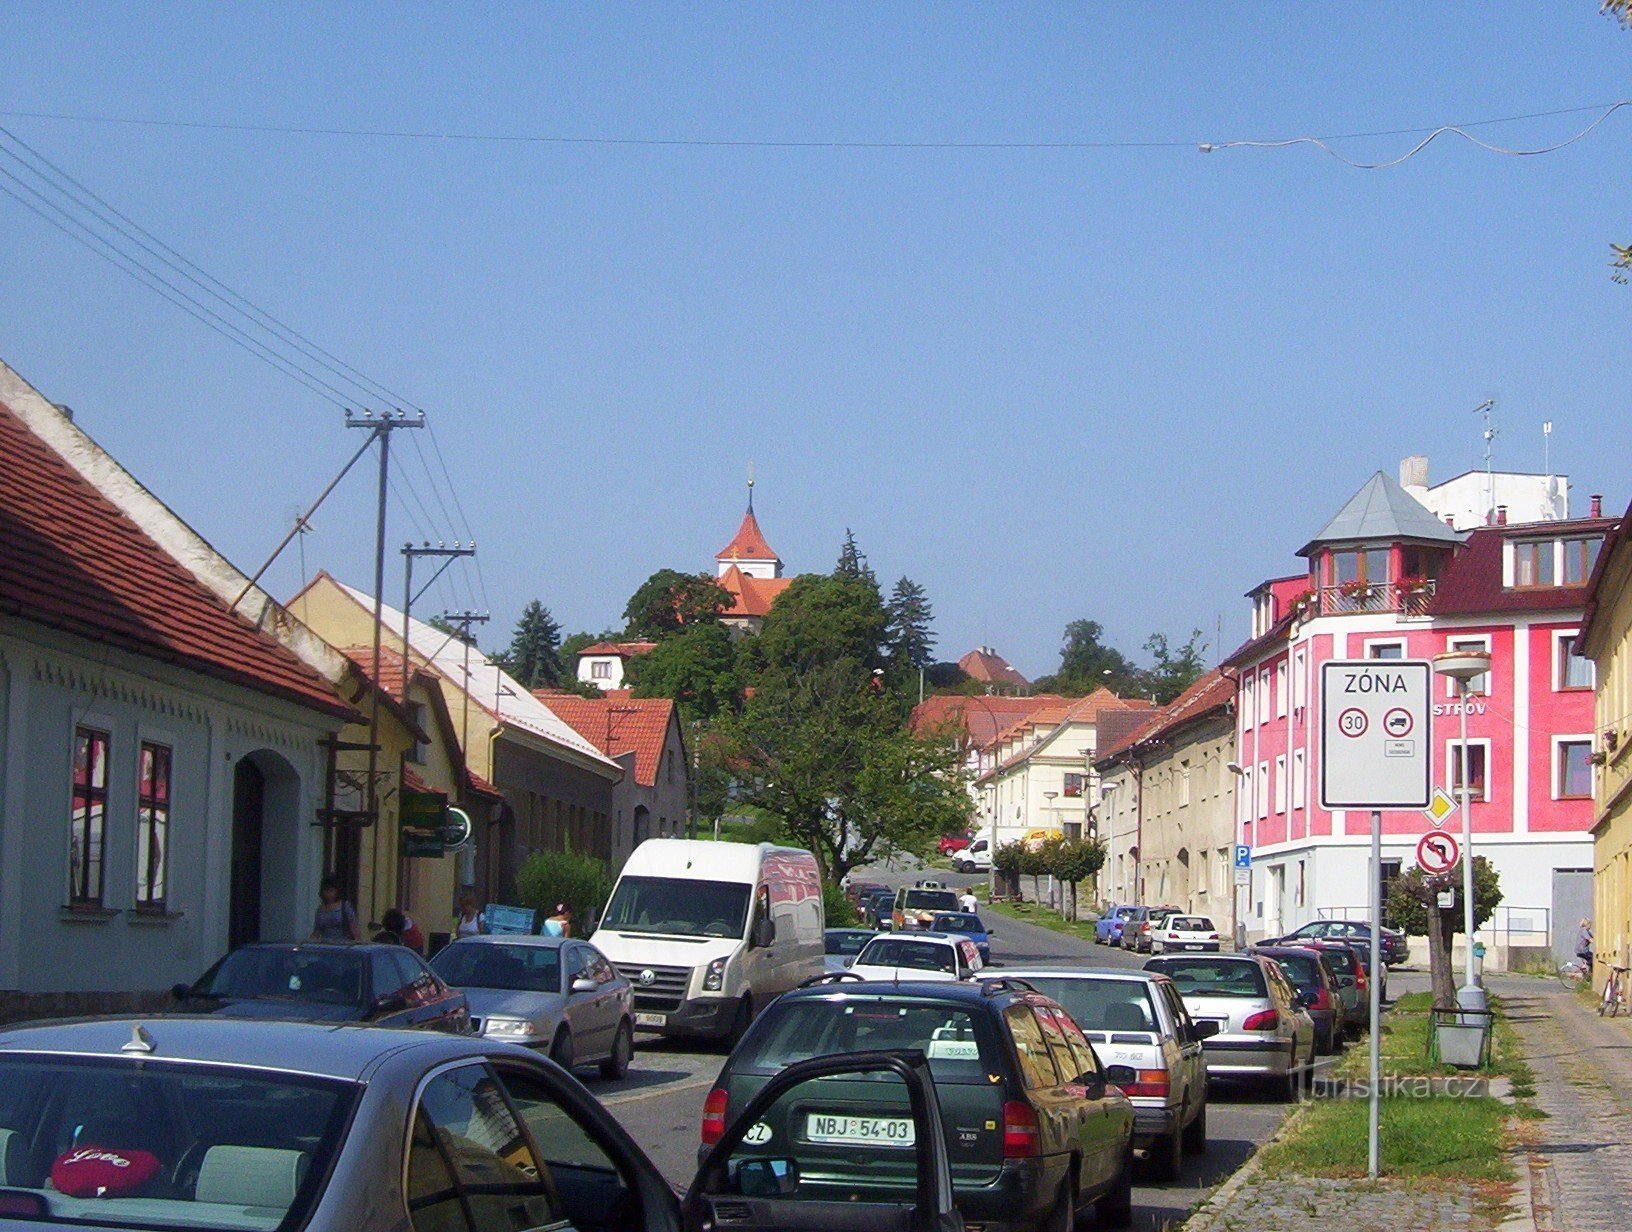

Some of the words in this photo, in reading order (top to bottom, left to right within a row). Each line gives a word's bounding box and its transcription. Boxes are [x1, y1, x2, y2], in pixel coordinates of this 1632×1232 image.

[1344, 668, 1408, 693] ZÓNA
[1433, 702, 1486, 716] STROV
[1344, 716, 1363, 730] 30
[1237, 847, 1248, 861] P
[746, 1125, 764, 1141] CZ
[816, 1117, 847, 1135] NBJ
[860, 1120, 908, 1138] 54-03
[959, 1133, 978, 1141] ABS
